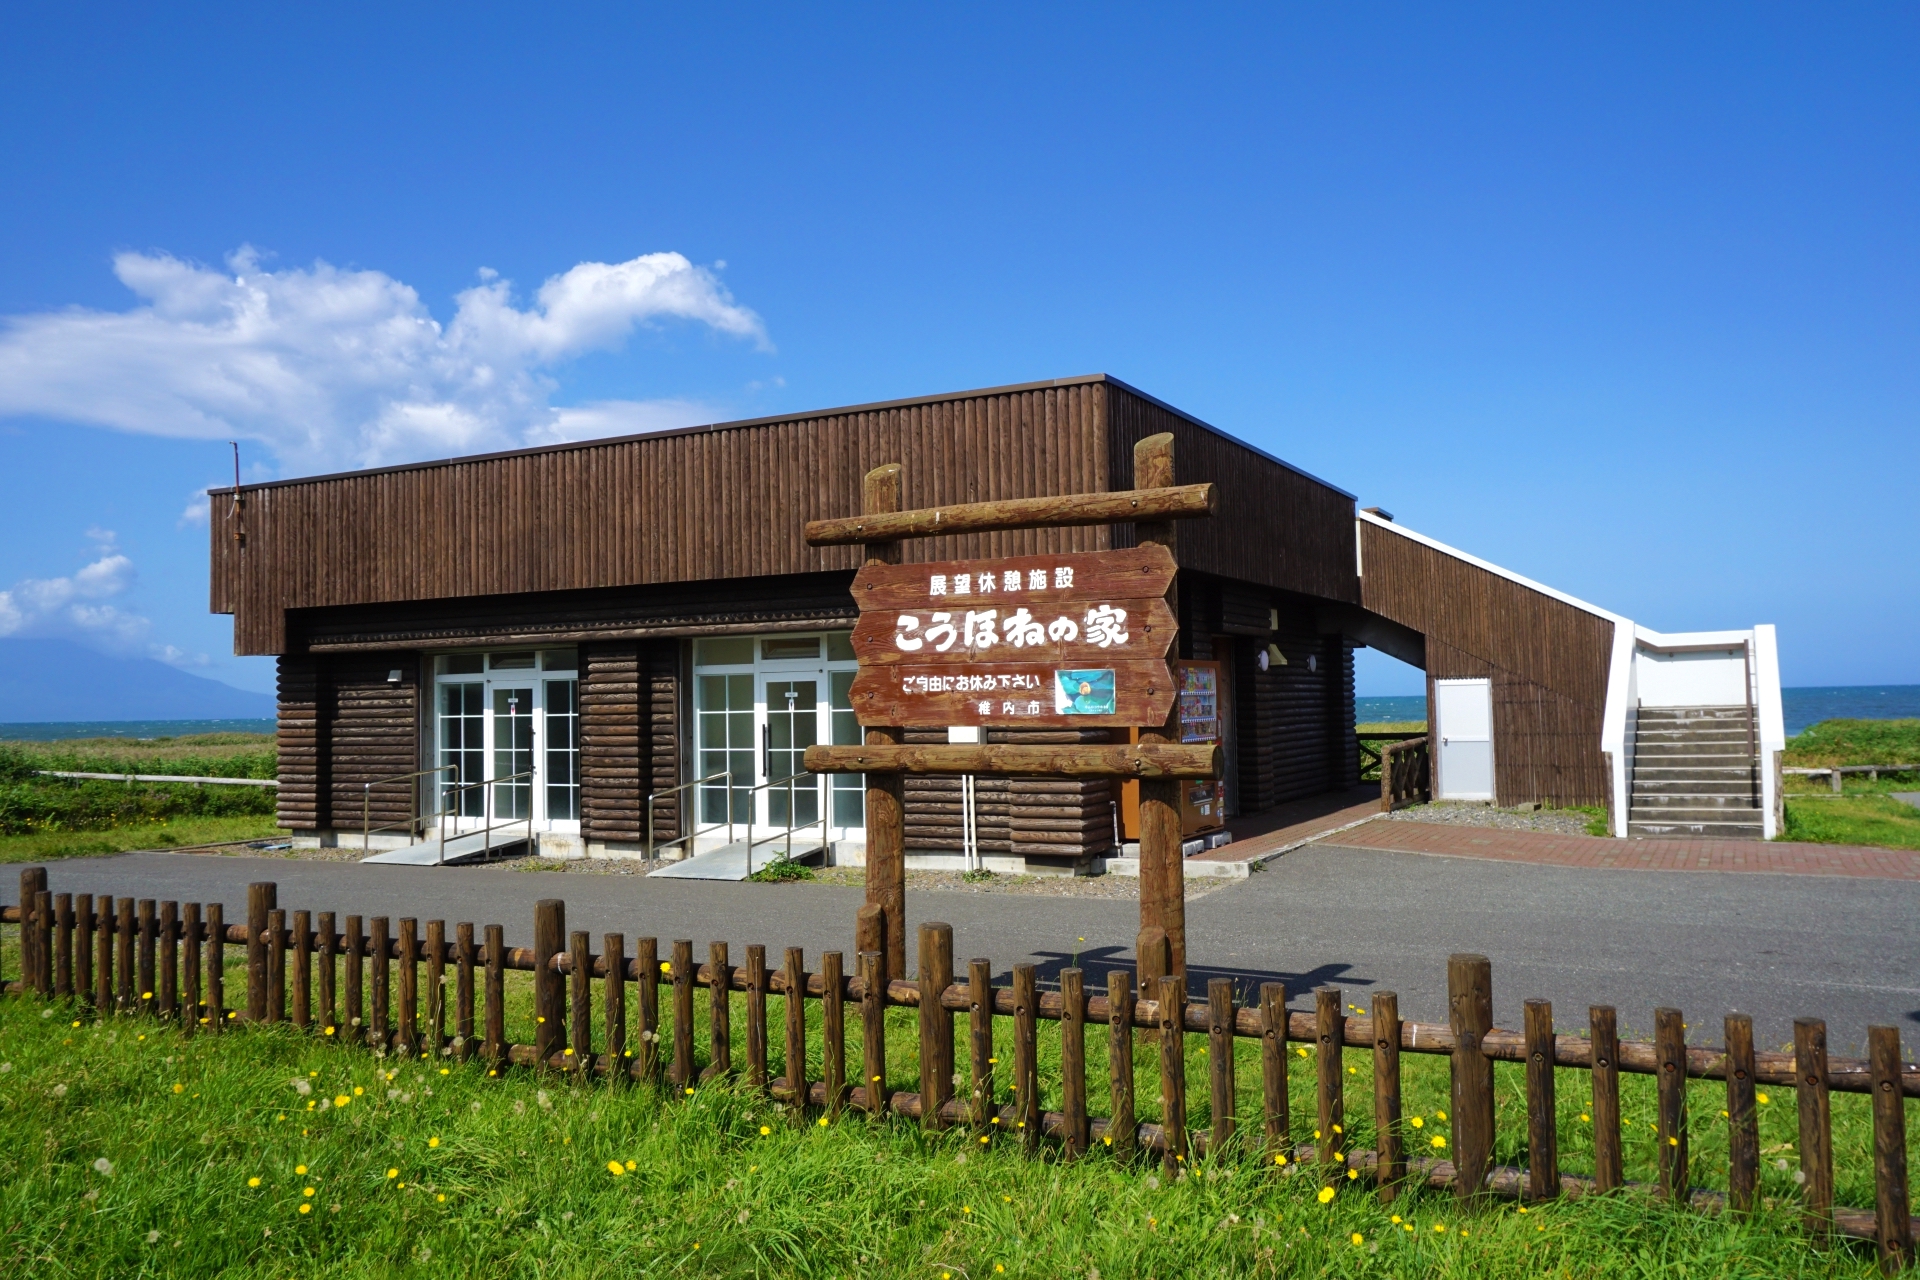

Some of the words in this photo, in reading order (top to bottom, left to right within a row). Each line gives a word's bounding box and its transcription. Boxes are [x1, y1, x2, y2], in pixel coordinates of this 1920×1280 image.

[929, 566, 1074, 596] 展望休憩施設
[895, 605, 1129, 652] こうほねの家
[978, 700, 1040, 715] 稚内市
